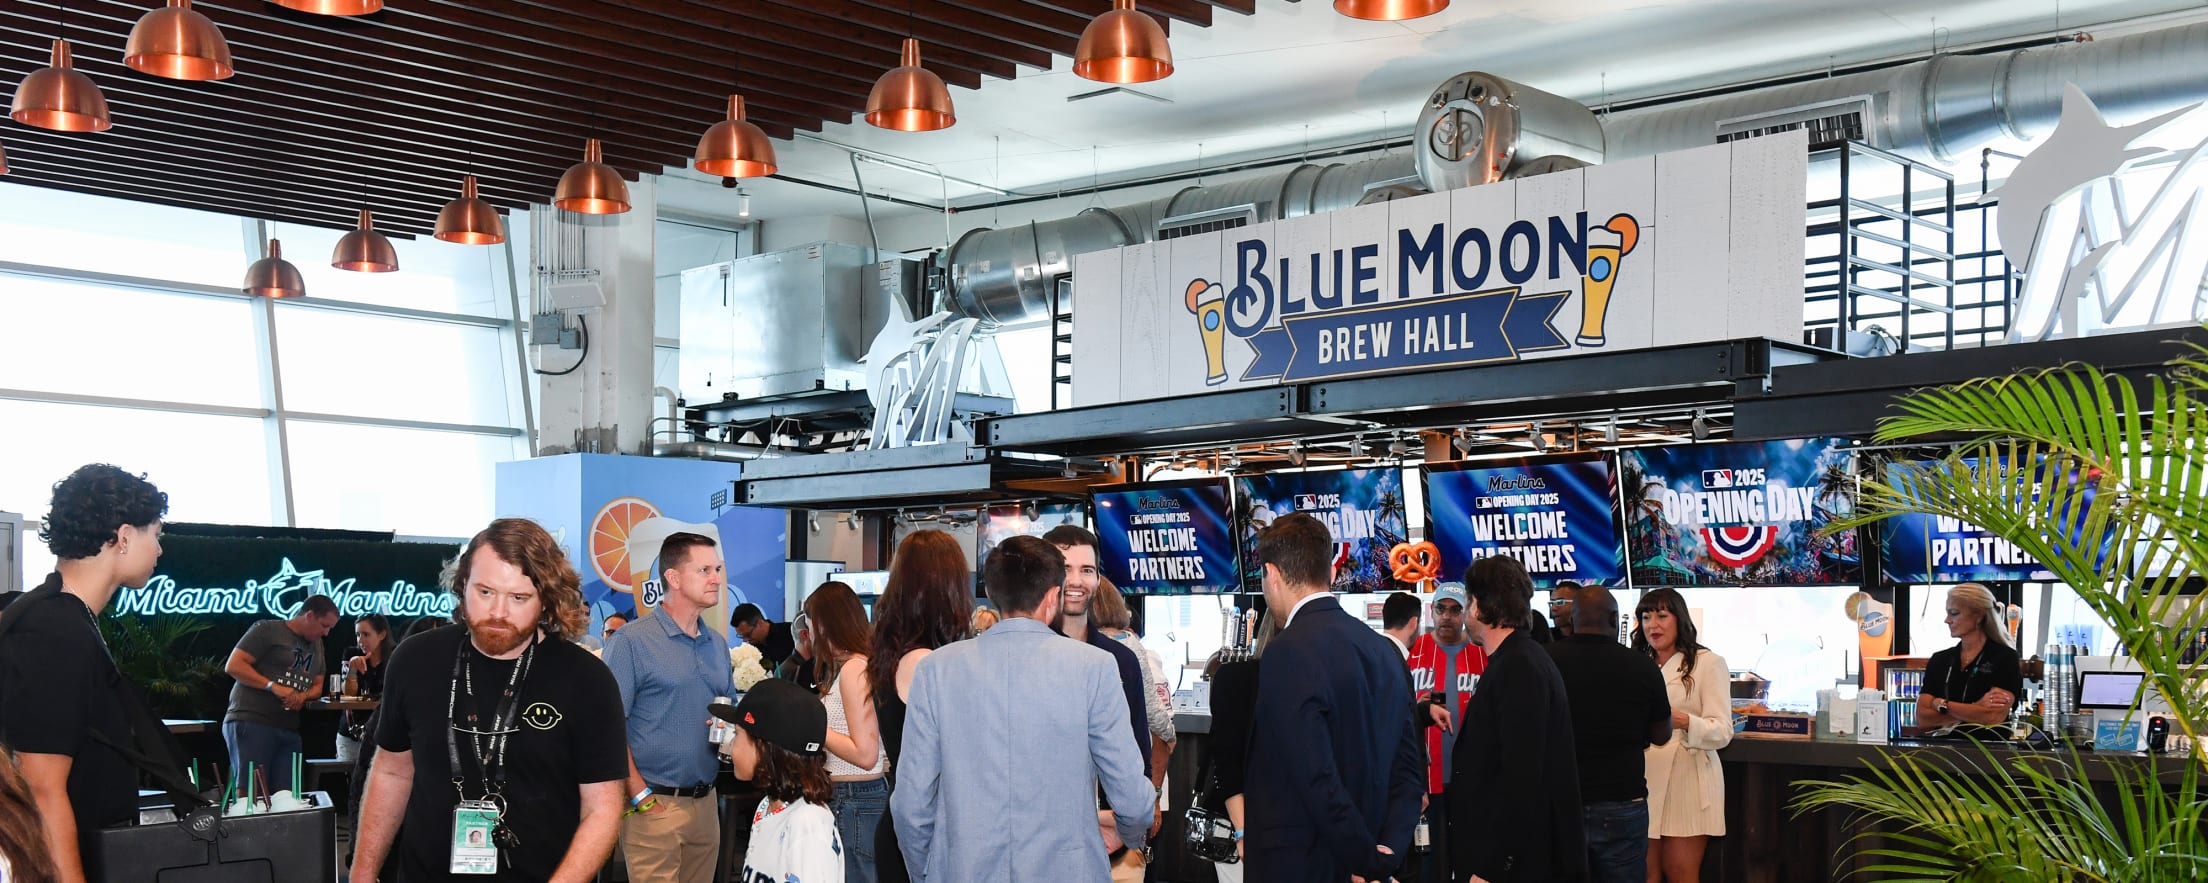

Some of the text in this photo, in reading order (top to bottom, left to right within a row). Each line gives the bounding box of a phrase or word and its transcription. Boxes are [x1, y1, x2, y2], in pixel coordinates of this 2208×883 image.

[1224, 211, 1588, 338] BLUE MOON
[1318, 312, 1474, 365] BREW HALL
[1486, 473, 1546, 494] Marlins
[1734, 468, 1766, 487] 2025
[1136, 495, 1180, 512] Marlins
[1317, 493, 1341, 508] 2025
[1492, 493, 1560, 508] OPENING DAY 2025
[1662, 483, 1816, 526] OPENING DAY
[1142, 512, 1191, 525] OPENING DAY 2025
[1340, 507, 1376, 539] DAY
[1471, 511, 1568, 542] WELCOME
[1127, 527, 1199, 553] WELCOME
[1128, 555, 1206, 581] PARTNERS
[112, 574, 258, 617] Miami
